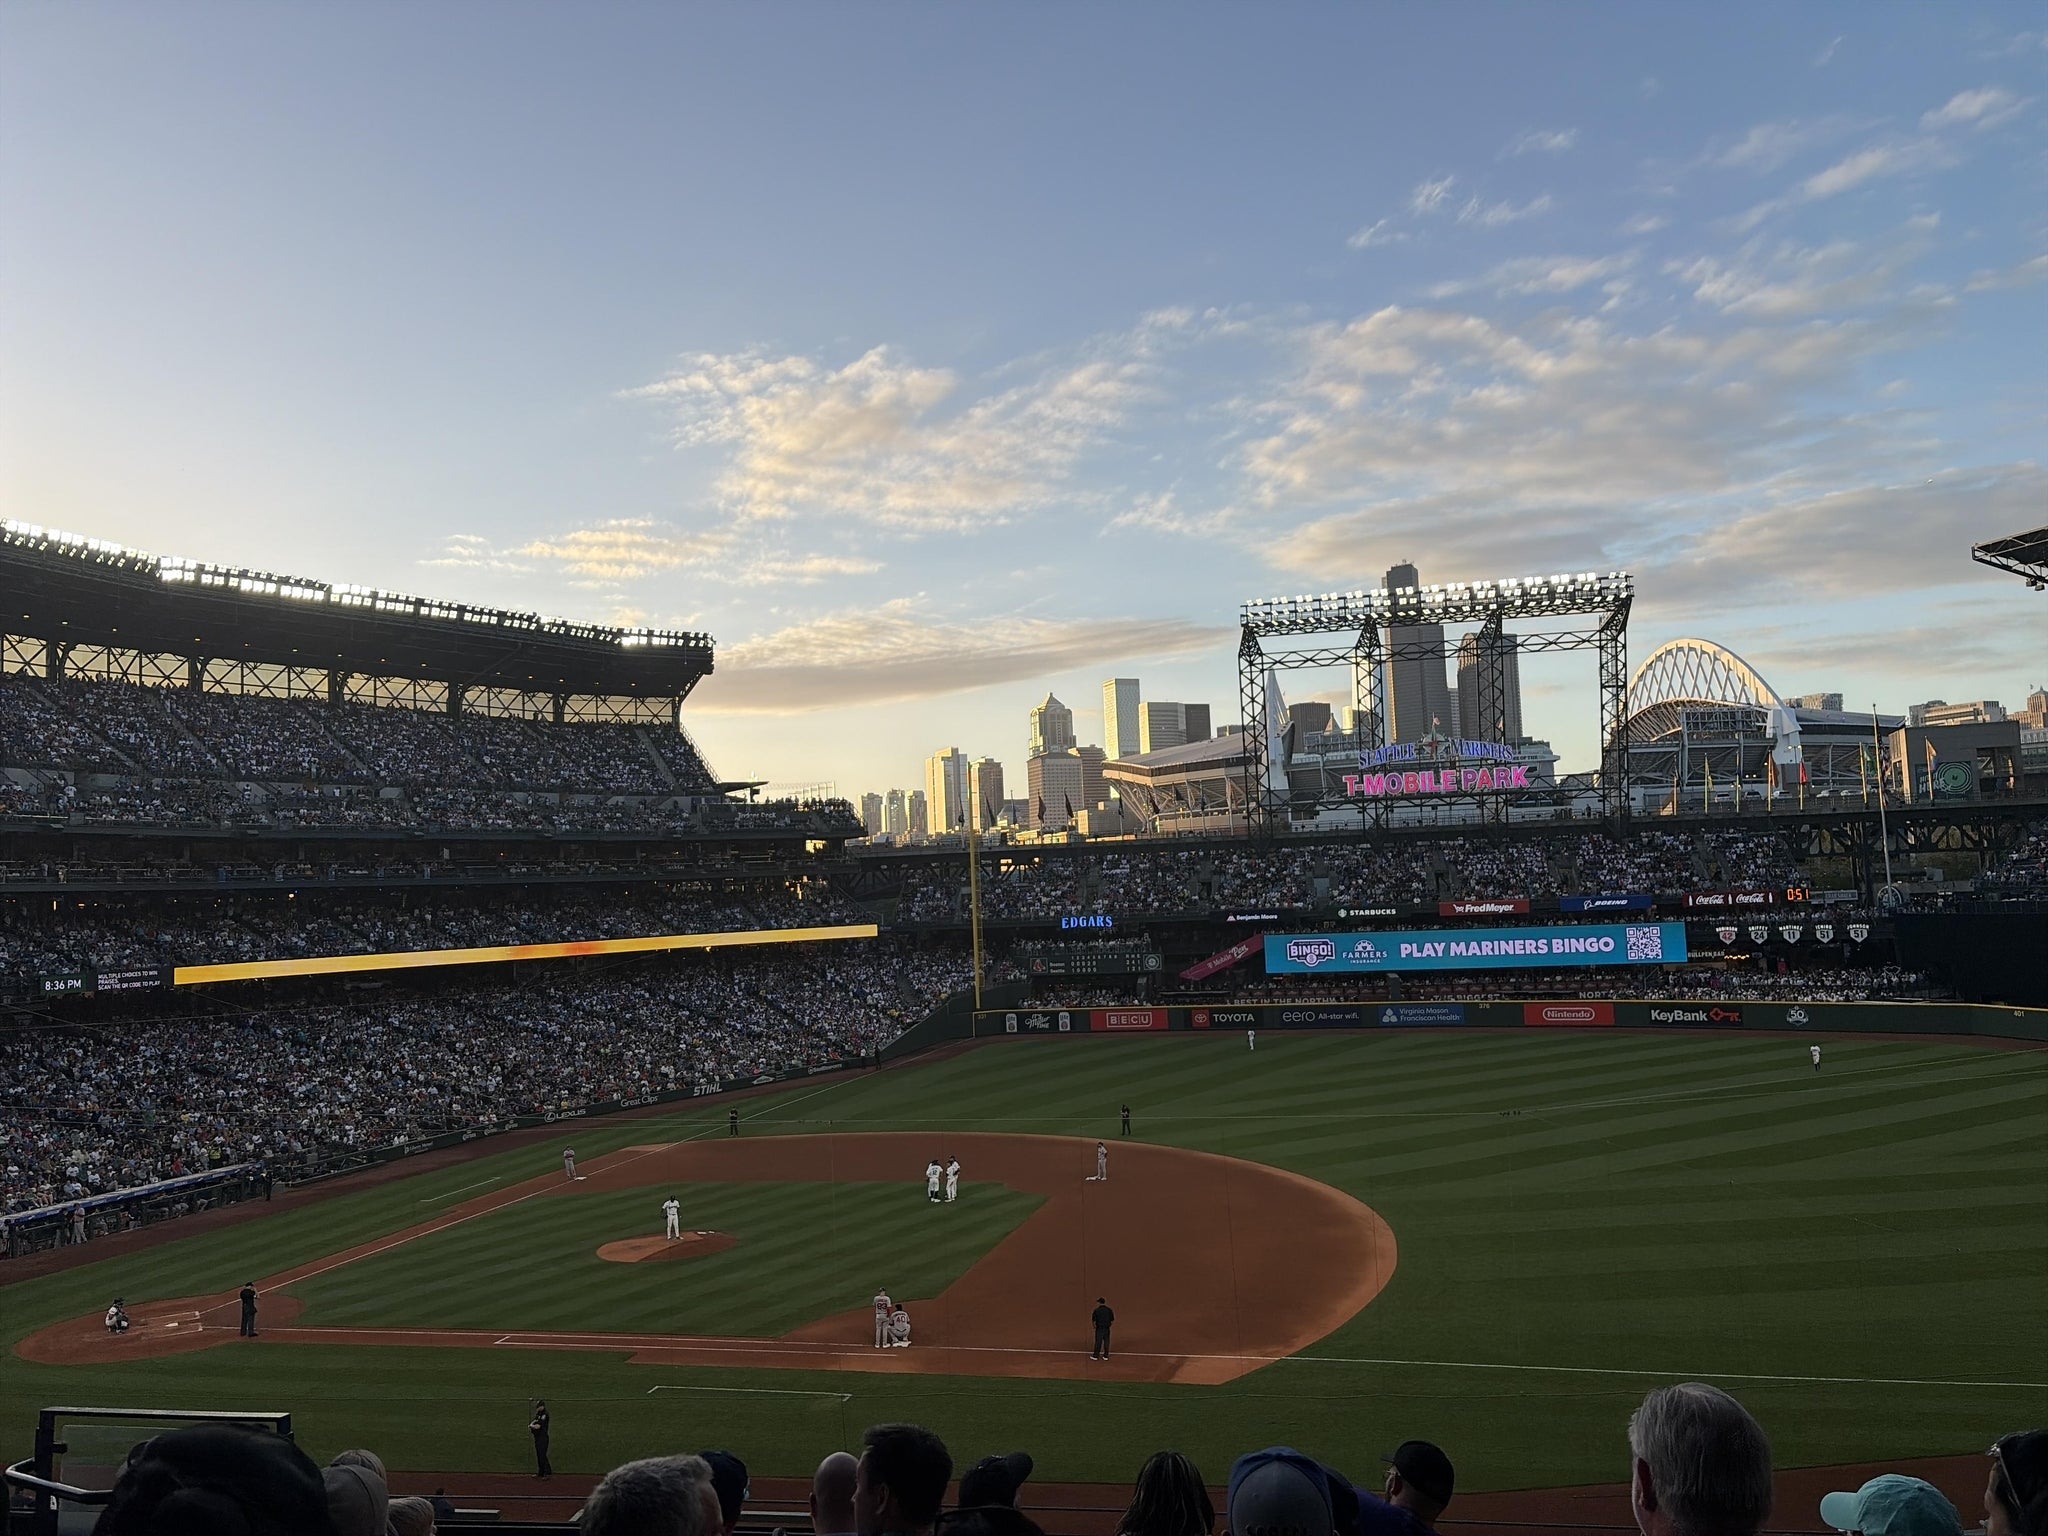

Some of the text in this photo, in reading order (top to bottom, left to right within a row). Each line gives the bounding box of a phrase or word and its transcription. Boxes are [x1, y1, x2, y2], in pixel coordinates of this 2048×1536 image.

[1359, 738, 1514, 769] SEATTLE MARINERS
[1343, 765, 1530, 797] T-MOBILE PARK
[1349, 908, 1397, 916] STARBUCKS
[1721, 932, 1734, 941] 42
[1753, 931, 1765, 940] 24
[1787, 931, 1796, 940] 11
[1820, 930, 1830, 939] 51
[1853, 929, 1864, 938] 51
[1290, 944, 1332, 957] BINGO!
[1400, 936, 1615, 958] PLAY MARINERS BINGO
[1342, 950, 1388, 959] FARMERS
[44, 979, 82, 991] 8:36 PM
[1282, 1011, 1316, 1022] eero
[1399, 1008, 1425, 1016] Virginia
[1547, 1010, 1592, 1019] Nintendo
[1651, 1009, 1708, 1022] KeyBank
[1790, 1010, 1805, 1019] 50
[1212, 1013, 1255, 1023] TOYOTA
[693, 1082, 723, 1097] STIHL
[620, 1095, 659, 1108] Great Clips
[555, 1108, 586, 1119] LEXUS
